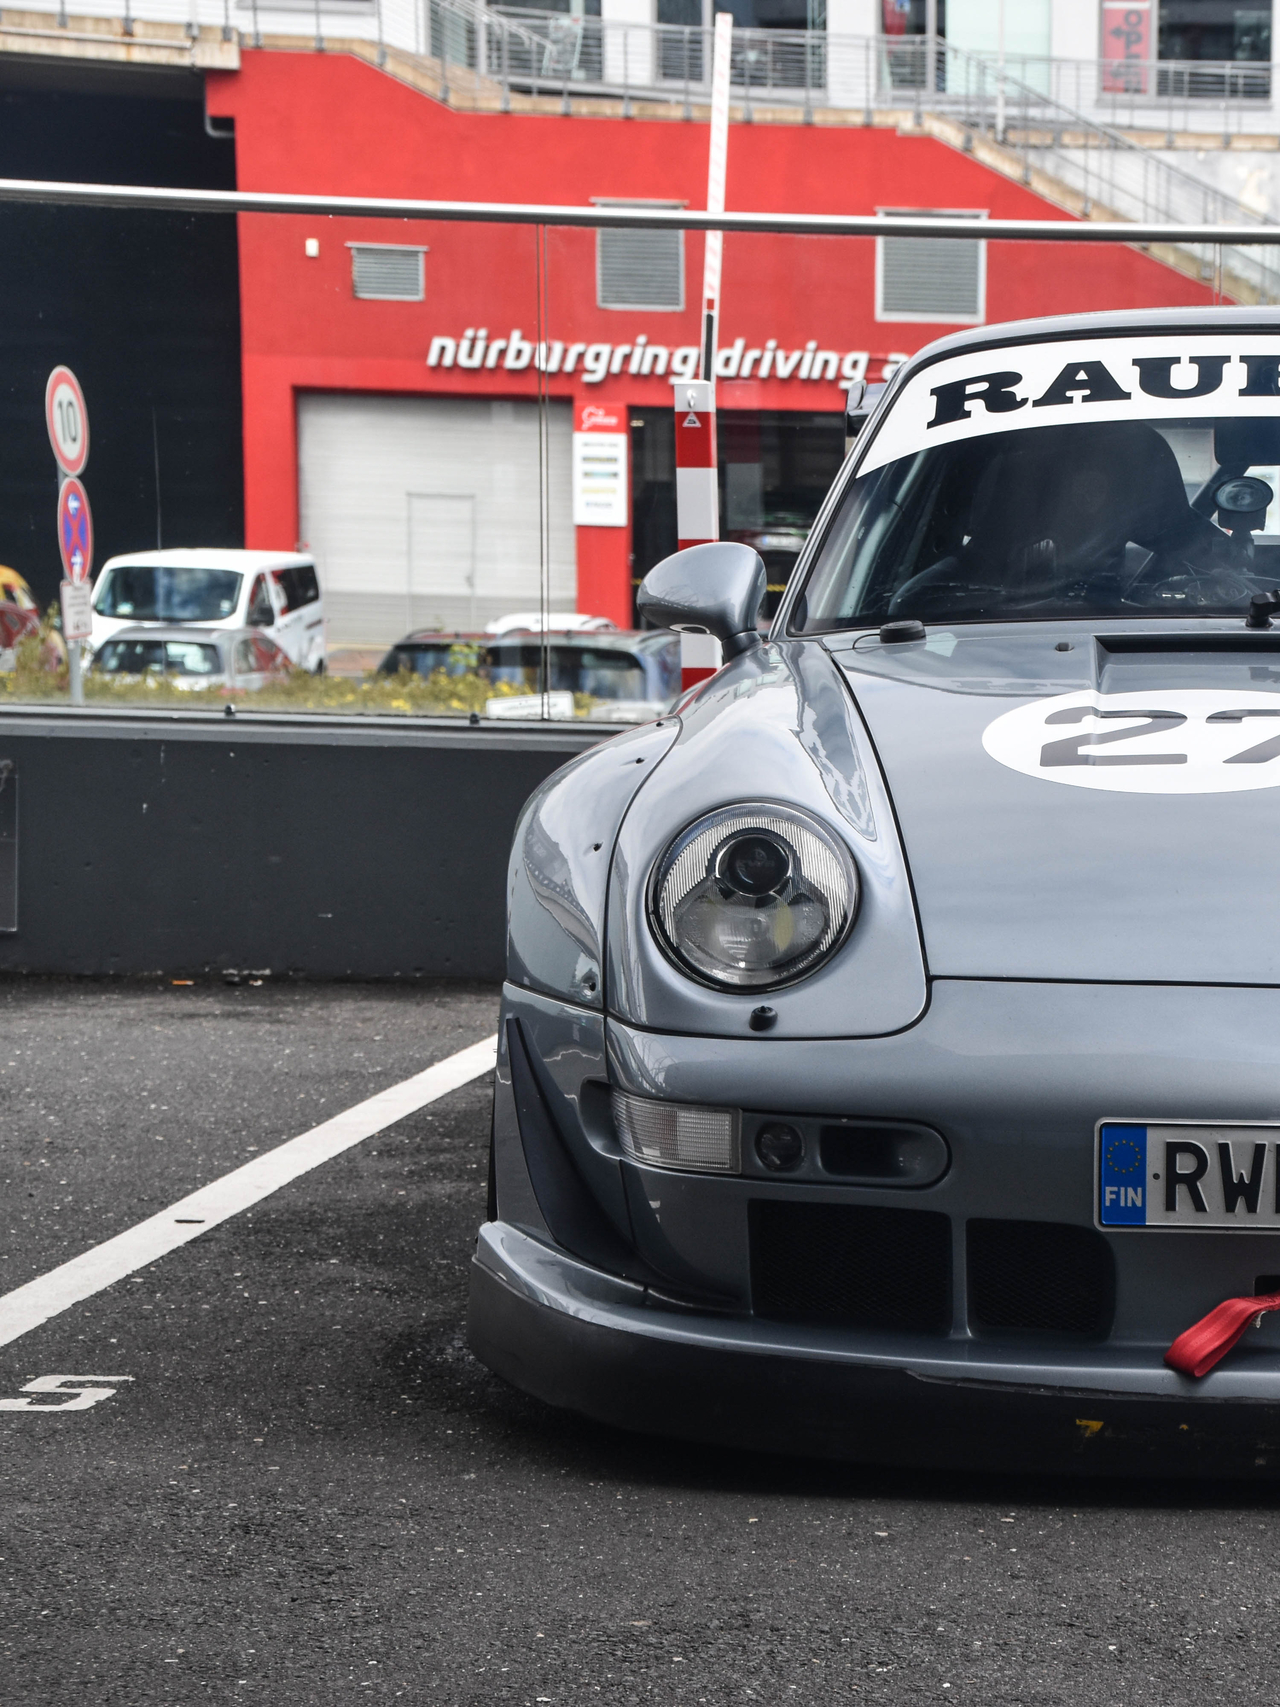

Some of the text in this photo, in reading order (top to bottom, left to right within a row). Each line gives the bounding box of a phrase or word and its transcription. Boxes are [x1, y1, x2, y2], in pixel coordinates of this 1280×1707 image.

[426, 328, 700, 384] nürburgring
[716, 337, 870, 388] driving
[57, 400, 78, 444] 10
[1104, 1186, 1143, 1208] FIN
